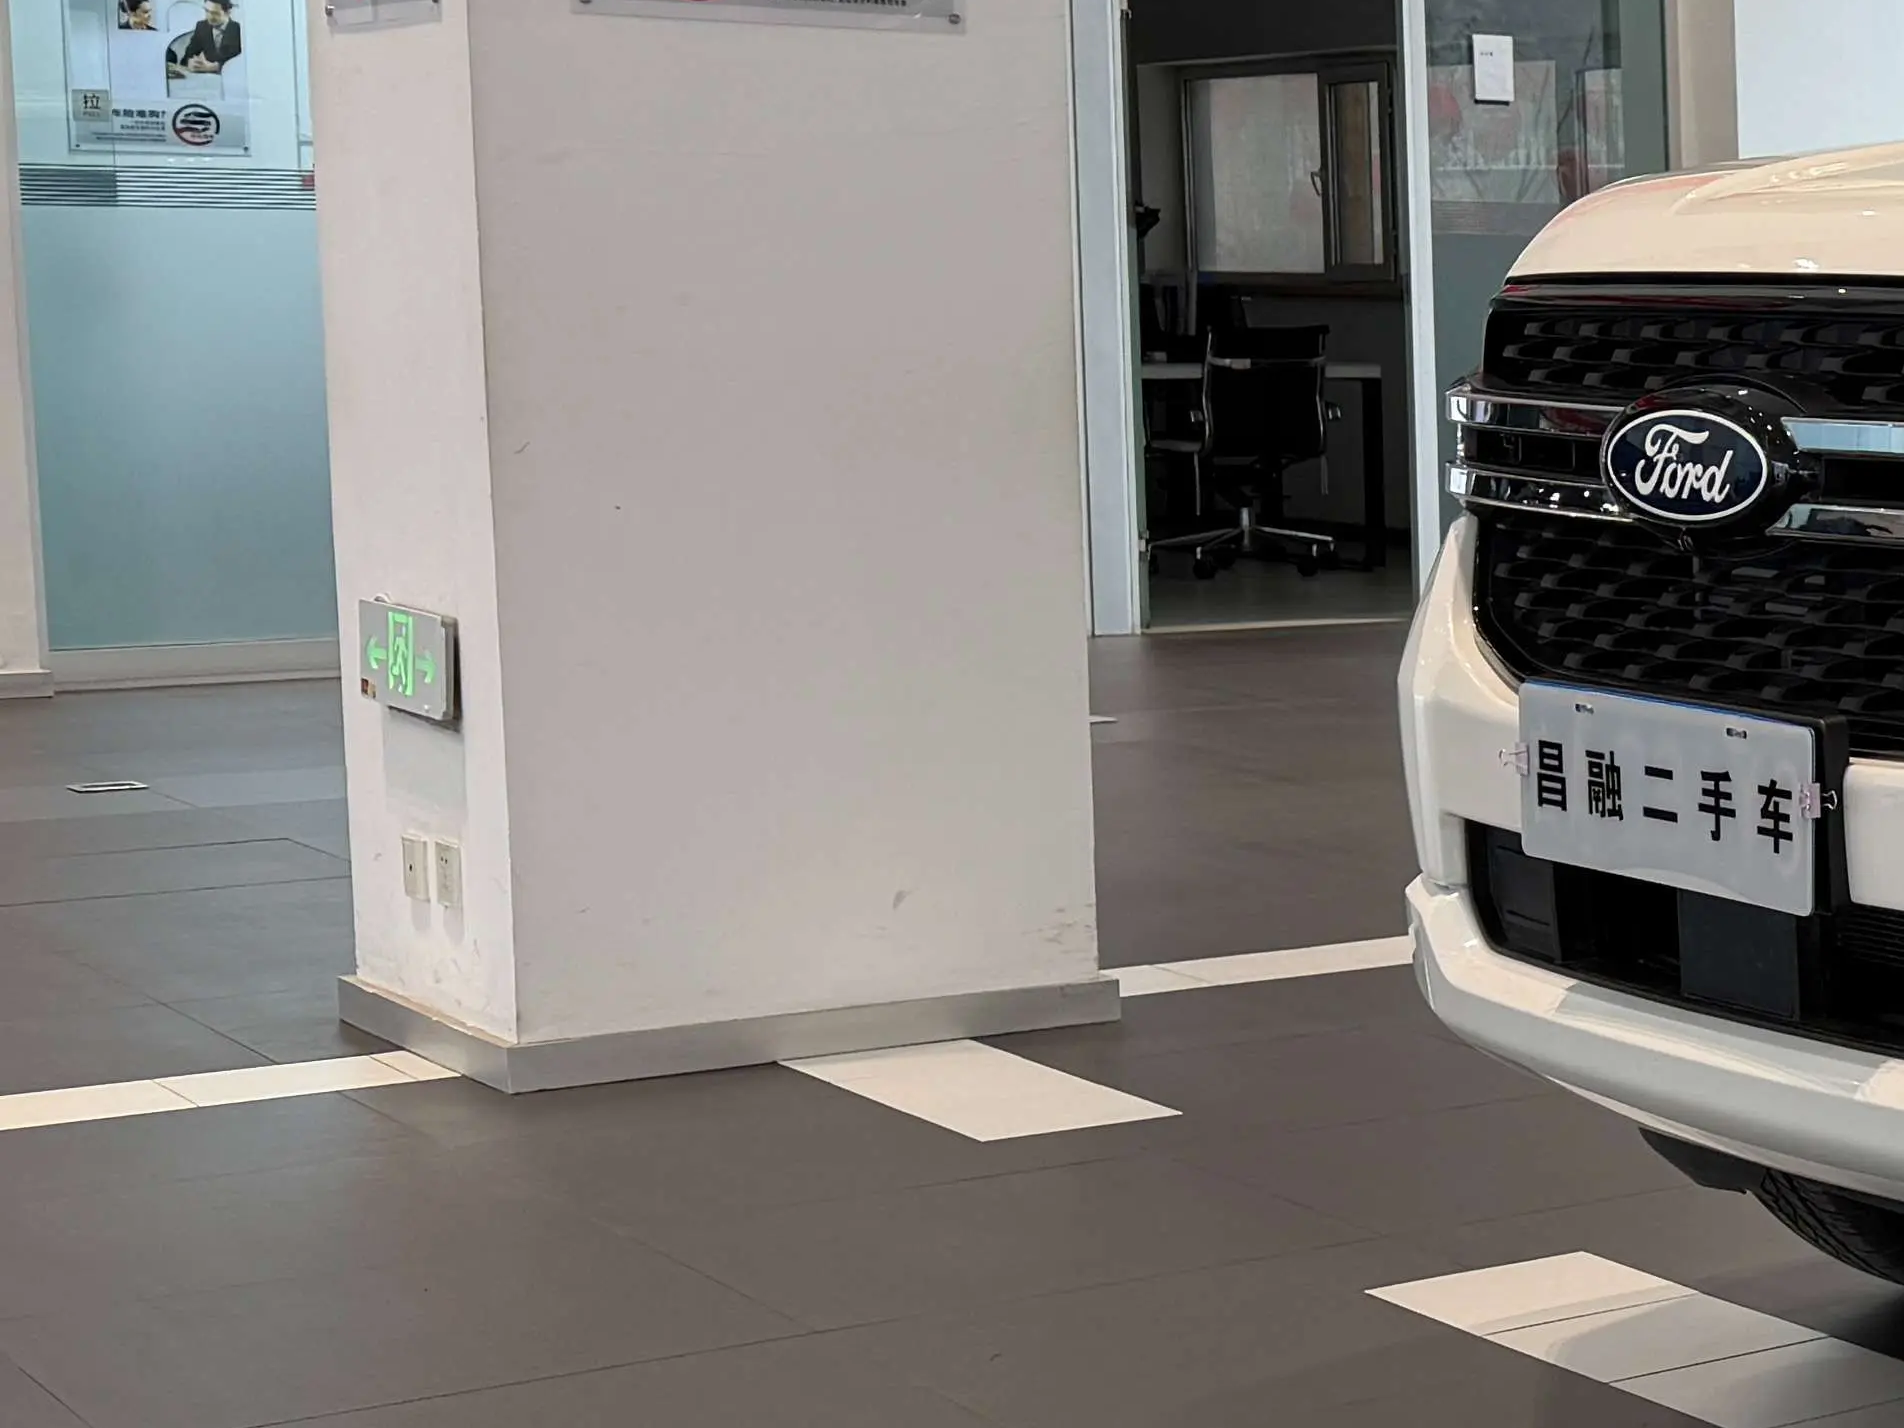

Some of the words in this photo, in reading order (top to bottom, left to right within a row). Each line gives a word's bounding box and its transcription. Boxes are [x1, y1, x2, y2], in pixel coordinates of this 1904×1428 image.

[83, 93, 101, 109] 拉
[1633, 423, 1734, 506] Ford
[1535, 739, 1795, 854] 昌融二手车
